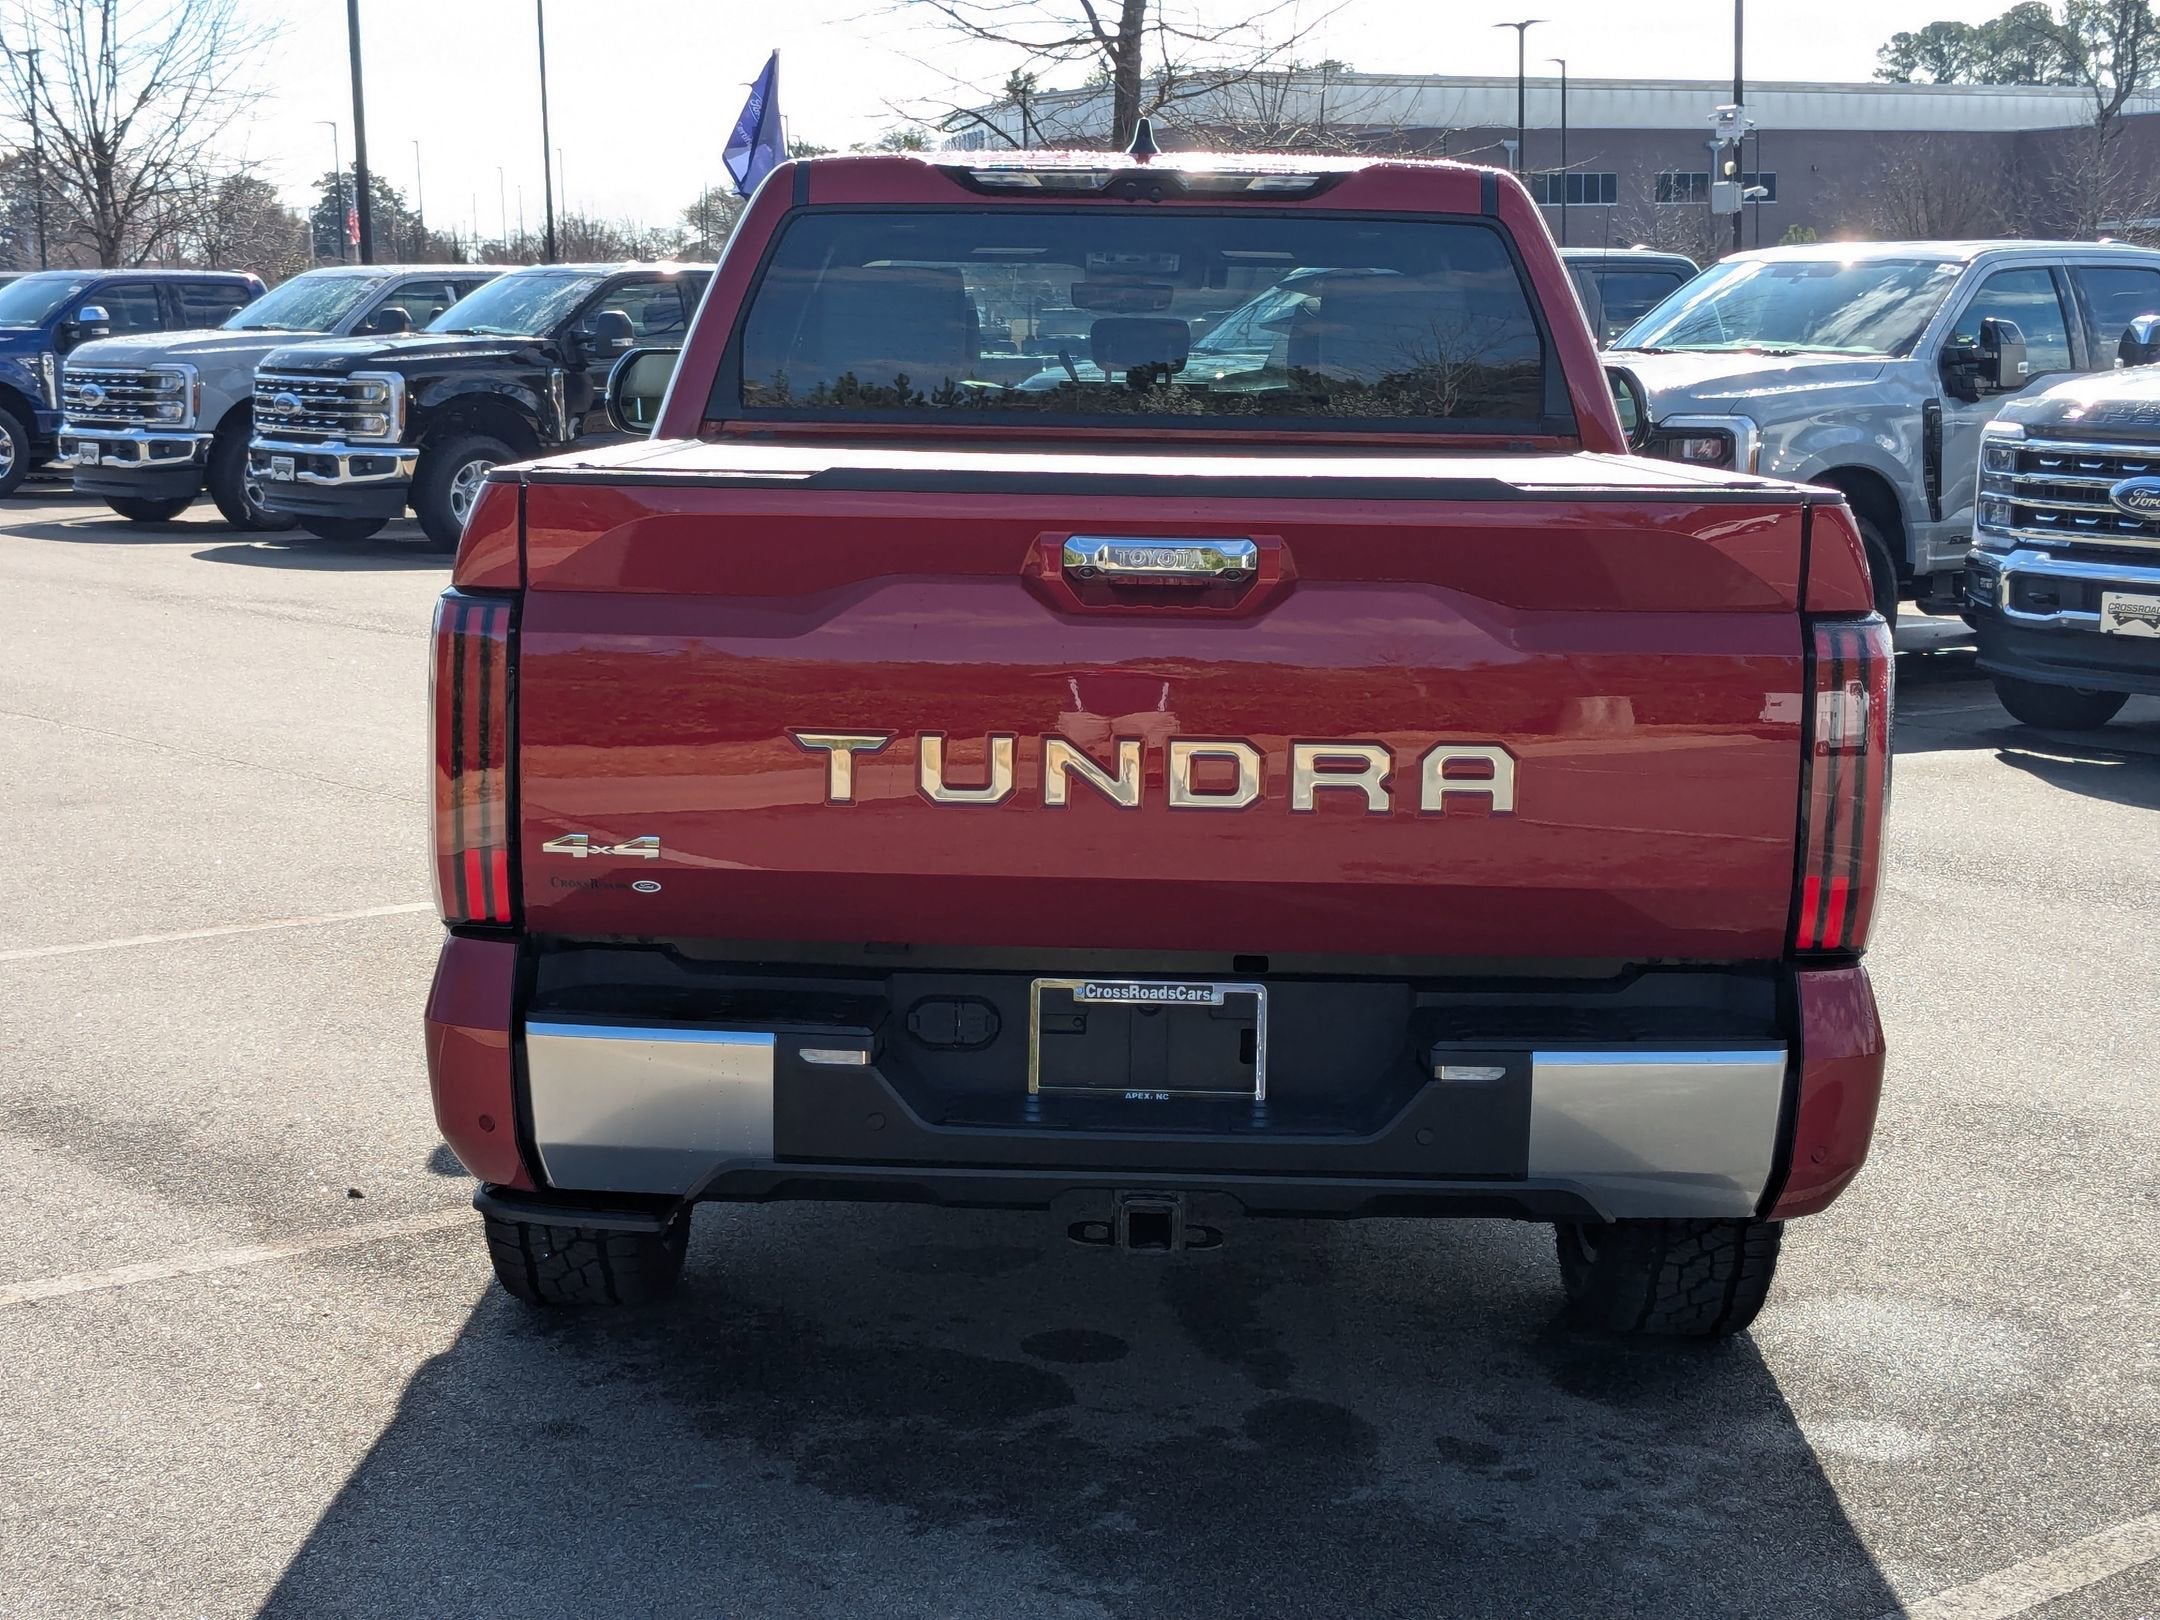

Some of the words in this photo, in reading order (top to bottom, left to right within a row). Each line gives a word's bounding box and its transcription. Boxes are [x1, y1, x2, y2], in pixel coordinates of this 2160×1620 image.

[1115, 548, 1206, 569] TOYOTA
[795, 732, 1519, 813] TUNDRA
[542, 834, 661, 859] 4x4
[1085, 983, 1212, 1001] CrossRoadsCars
[1156, 1093, 1170, 1101] NC
